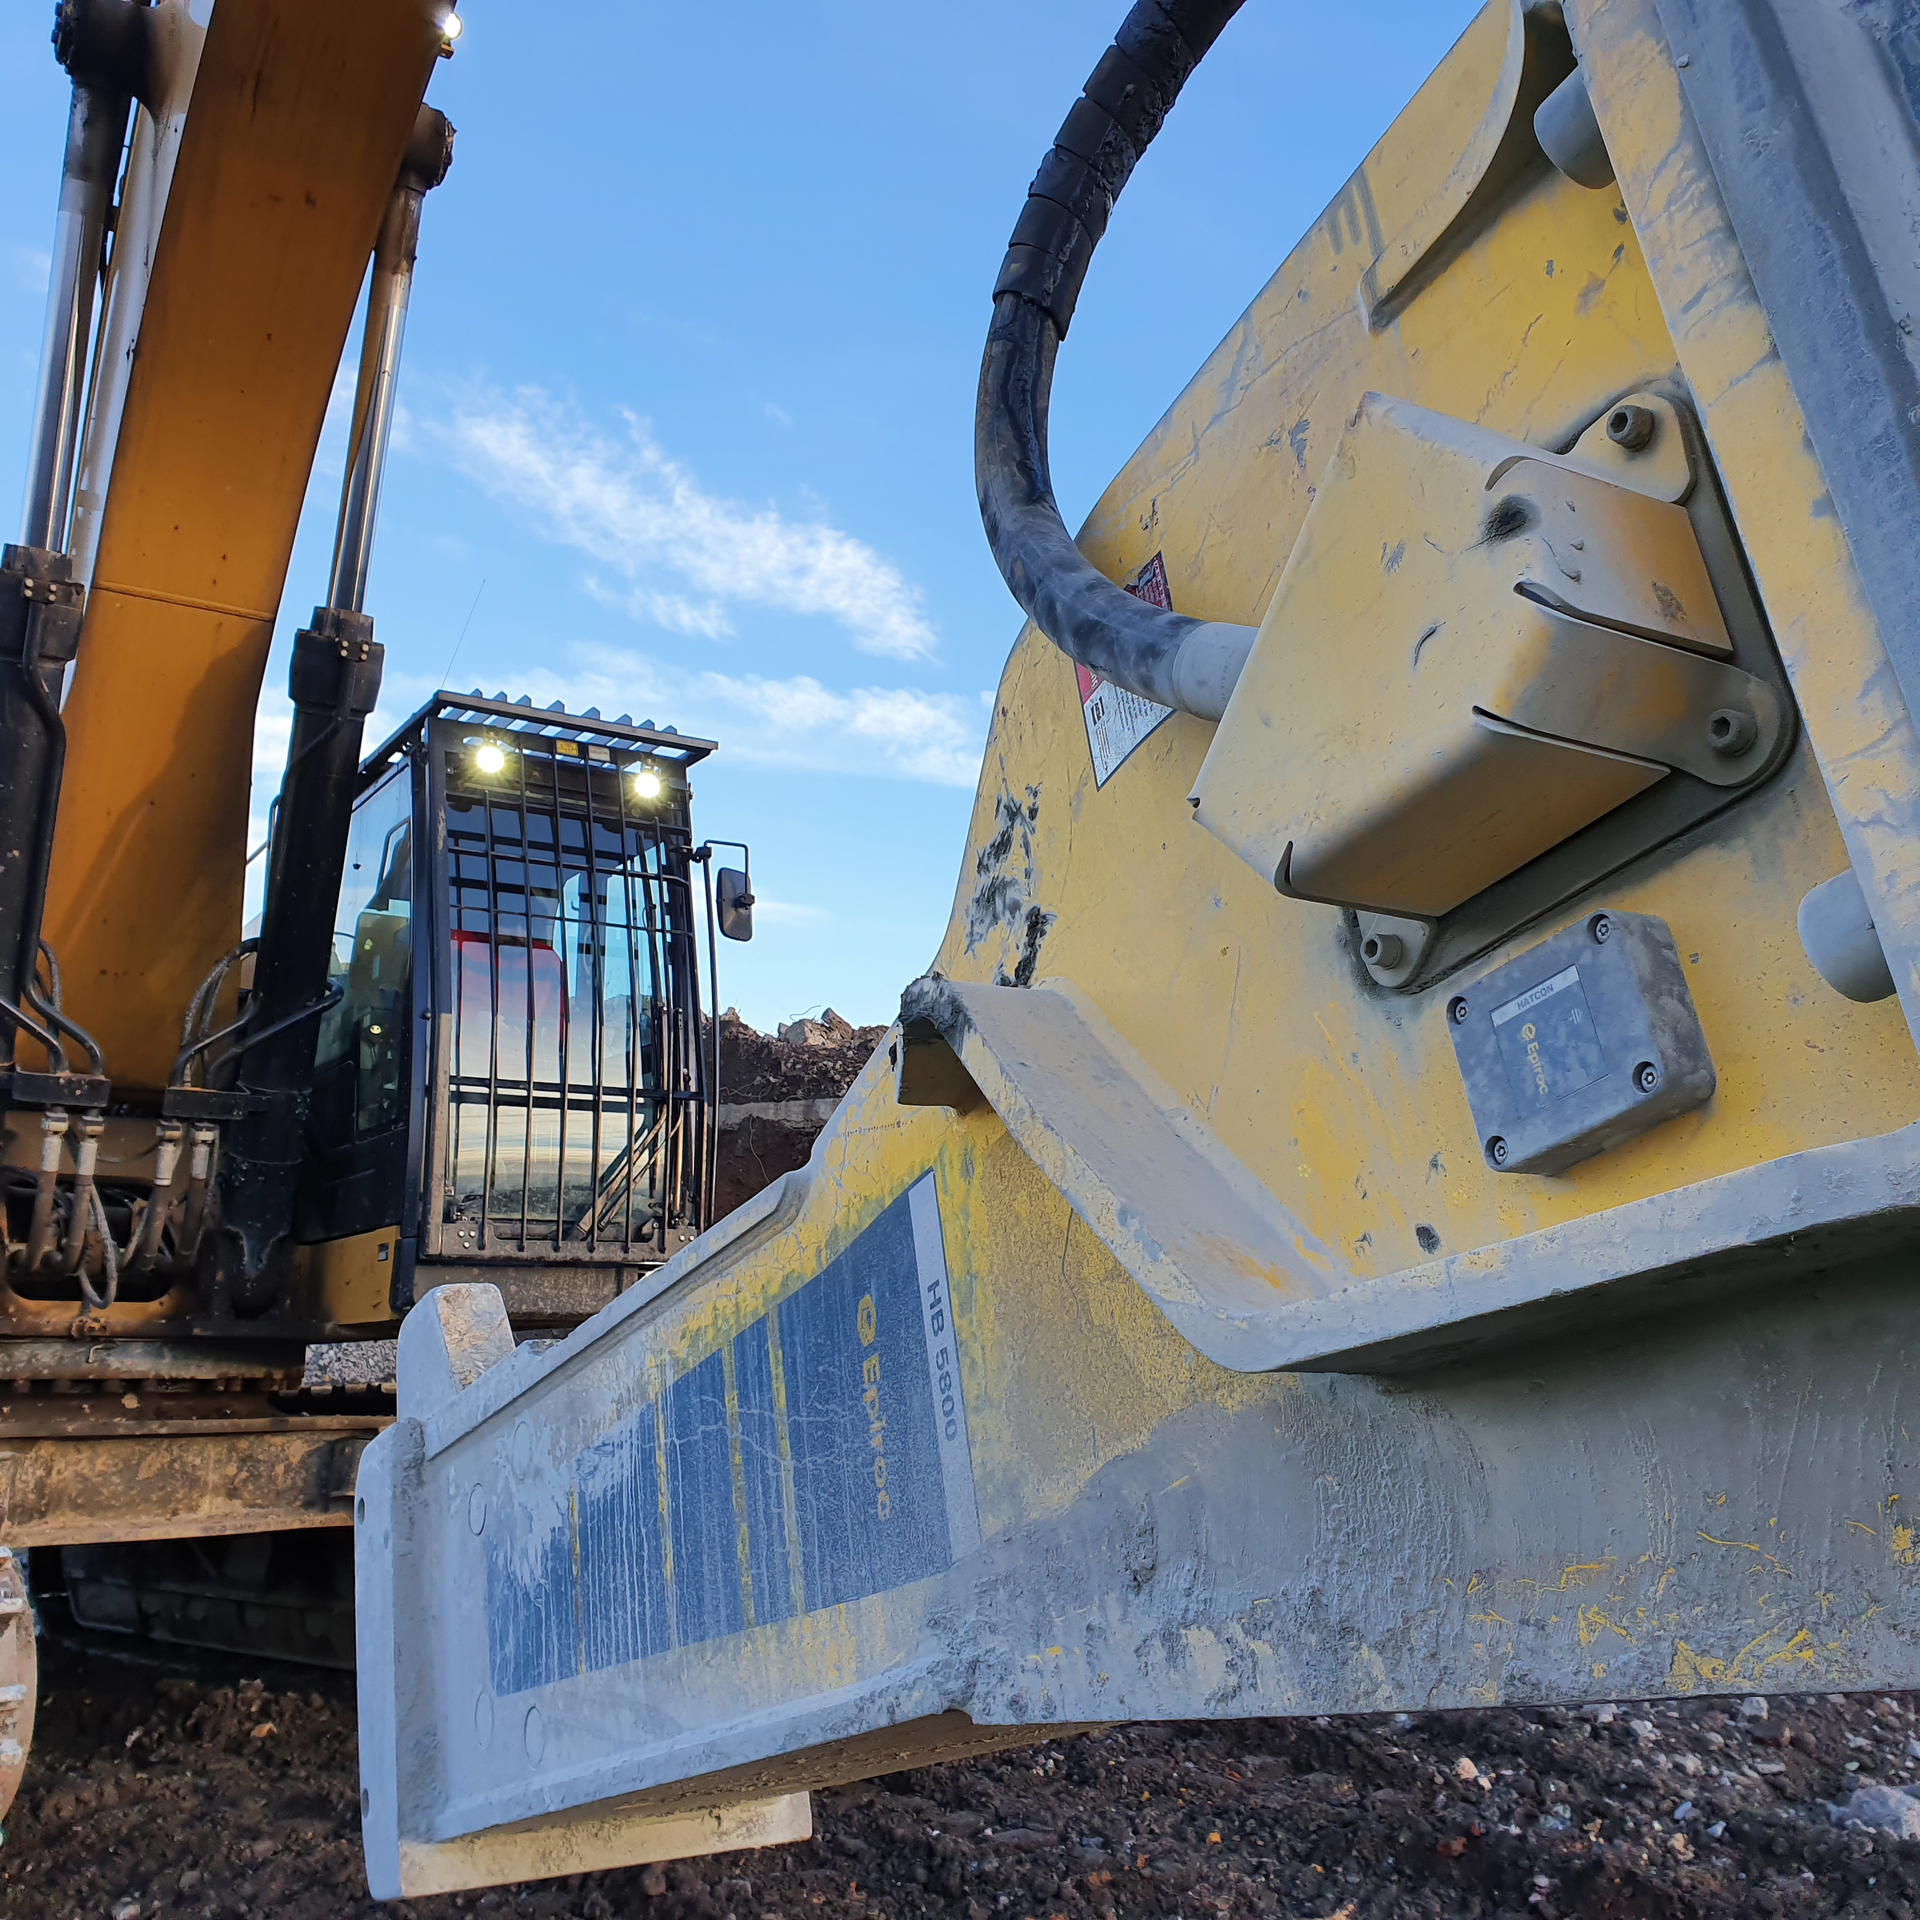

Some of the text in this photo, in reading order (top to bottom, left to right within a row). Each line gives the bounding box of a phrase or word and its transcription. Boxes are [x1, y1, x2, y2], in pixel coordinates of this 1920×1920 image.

[1516, 983, 1554, 1011] HATCON
[1526, 1041, 1549, 1095] Epiroc
[927, 1279, 958, 1443] HB 5800
[863, 1353, 890, 1522] Epiroc
